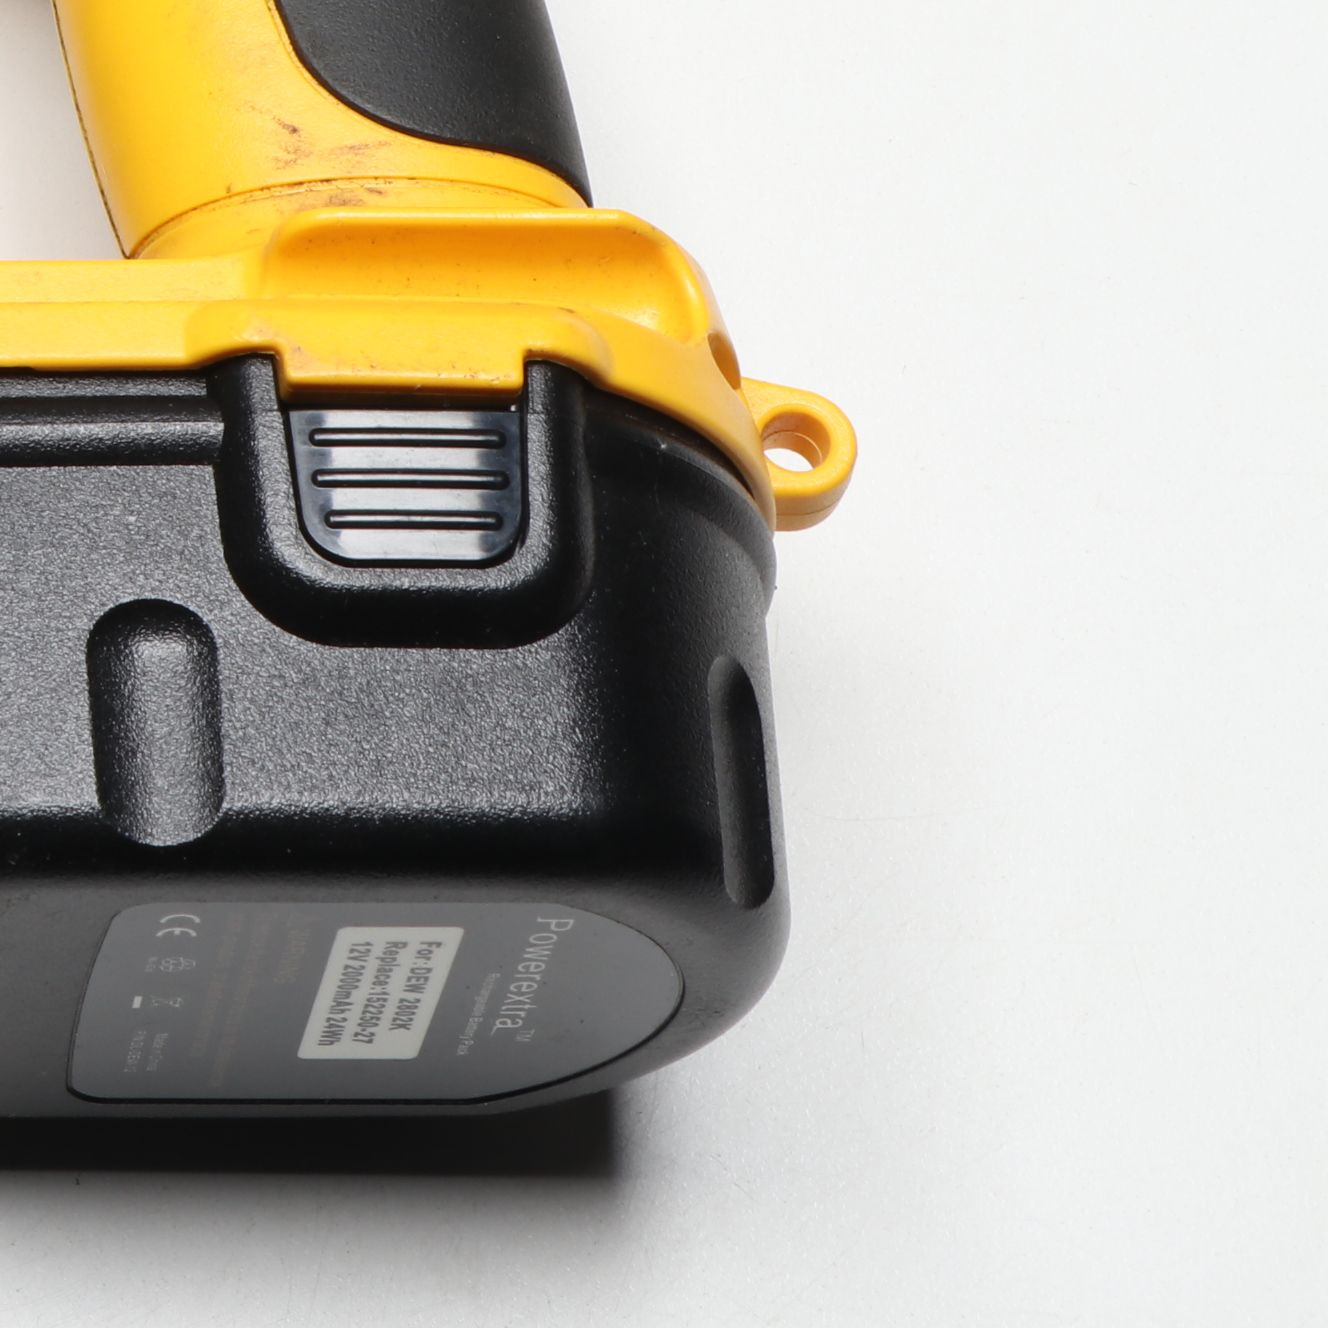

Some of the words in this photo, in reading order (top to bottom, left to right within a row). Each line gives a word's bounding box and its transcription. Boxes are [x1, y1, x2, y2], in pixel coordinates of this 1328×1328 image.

[350, 941, 374, 962] 12V
[328, 964, 365, 1015] 2000mAh
[491, 916, 574, 1037] Powerextra
[318, 1016, 348, 1047] 24Wh
[388, 997, 421, 1032] 2802K
